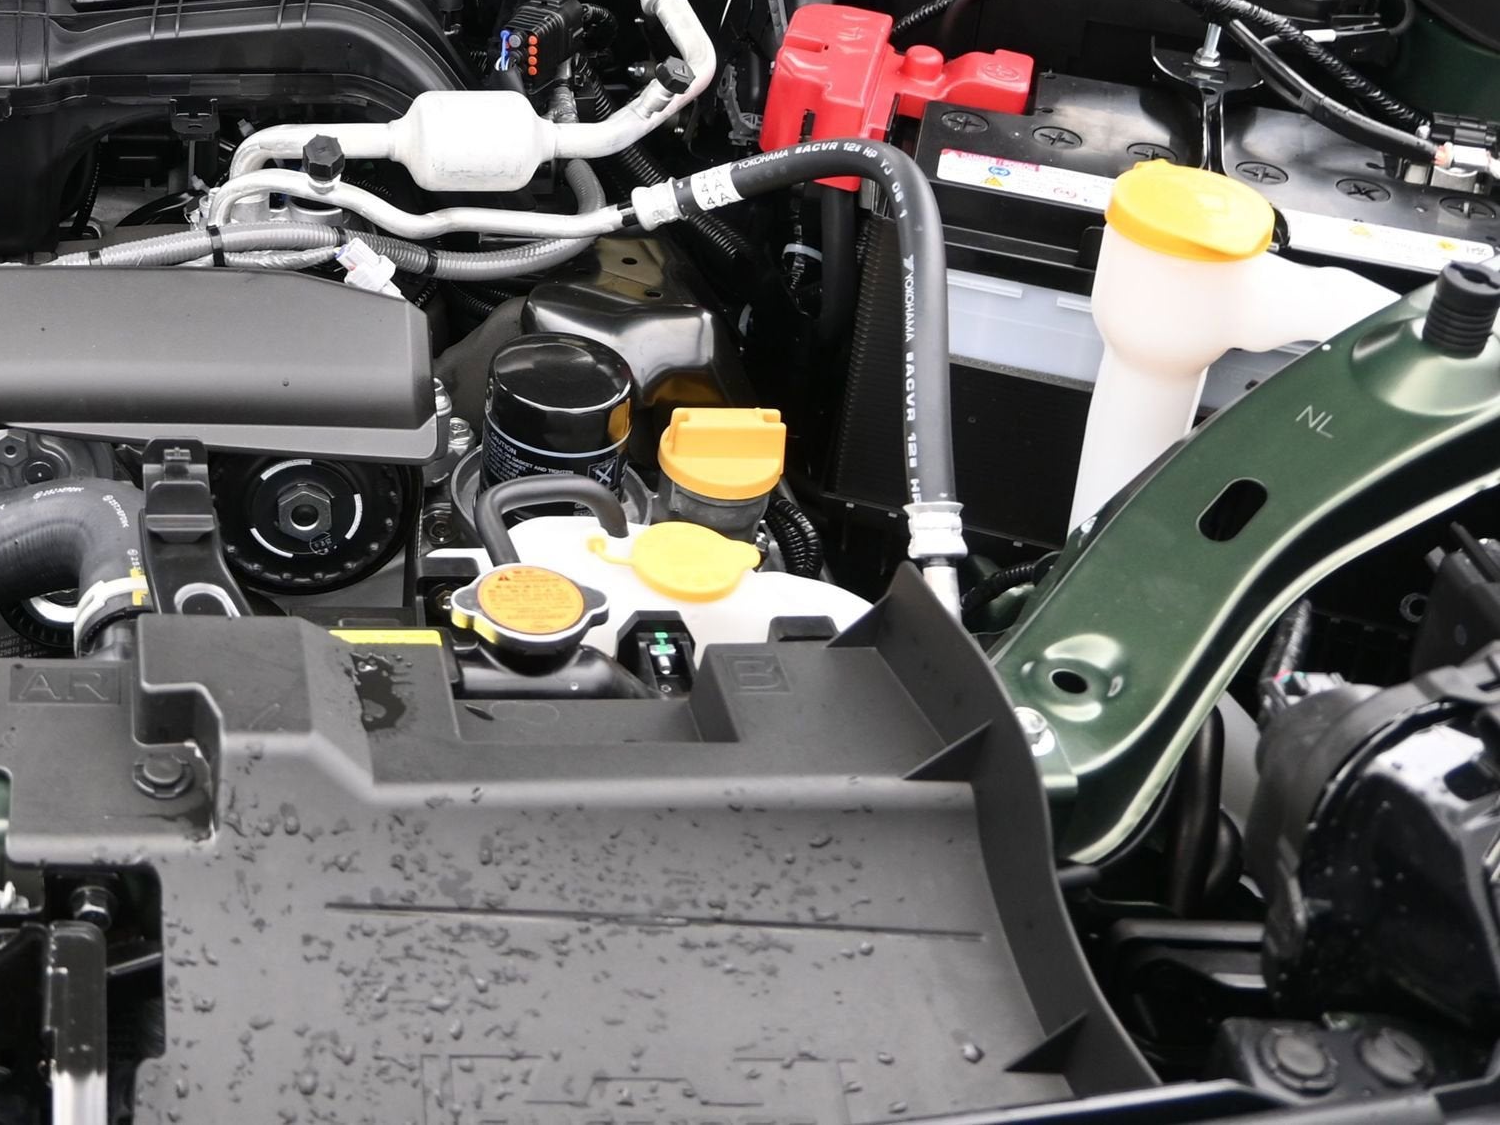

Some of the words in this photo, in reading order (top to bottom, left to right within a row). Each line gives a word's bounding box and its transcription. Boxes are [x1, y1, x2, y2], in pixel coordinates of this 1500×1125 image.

[737, 149, 789, 170] YOKOHAMA
[904, 271, 916, 343] YOKOHAMA
[1295, 404, 1334, 438] NL
[491, 432, 517, 455] CAUTION
[19, 671, 109, 701] AR
